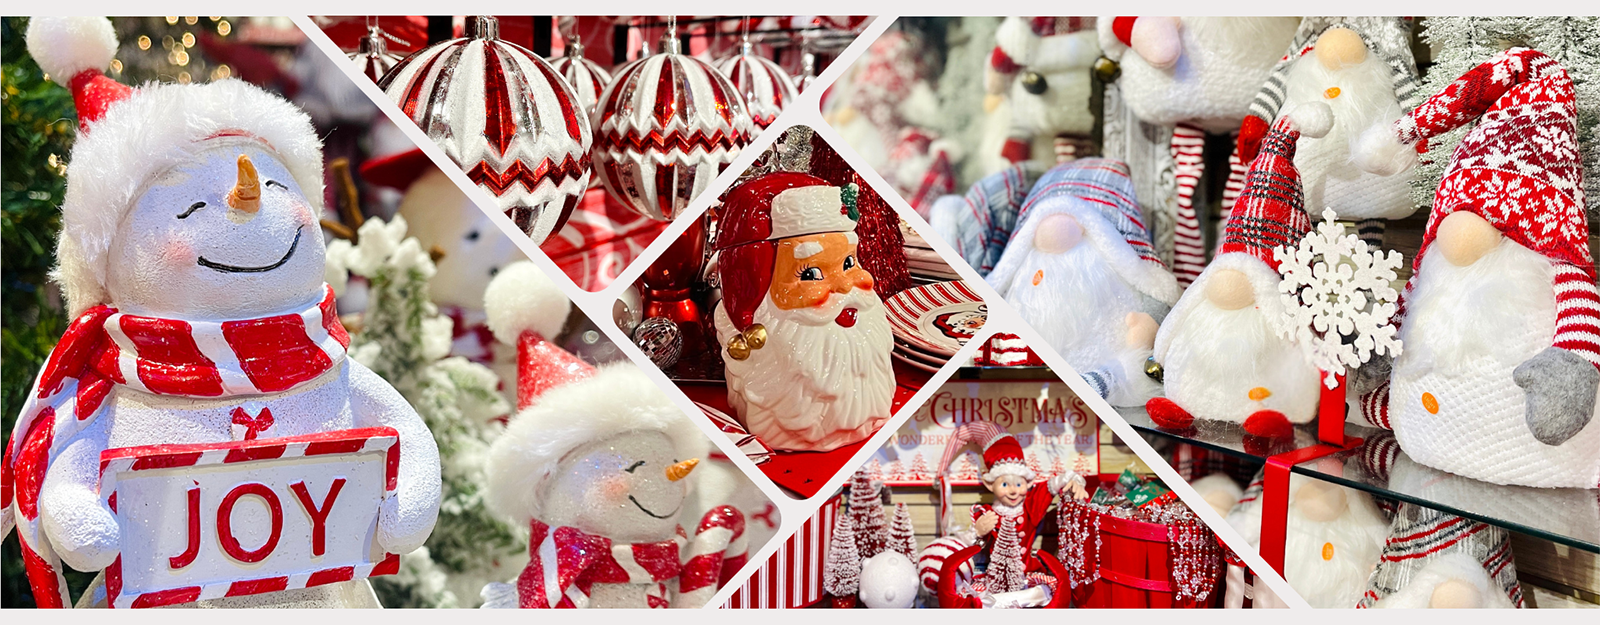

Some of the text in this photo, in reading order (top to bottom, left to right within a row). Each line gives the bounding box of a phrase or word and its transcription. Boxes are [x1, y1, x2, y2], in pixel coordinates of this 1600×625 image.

[929, 391, 1088, 430] CHRISTMAS
[889, 434, 952, 446] WONDERF
[1025, 434, 1053, 445] THE
[168, 478, 347, 570] JOY
